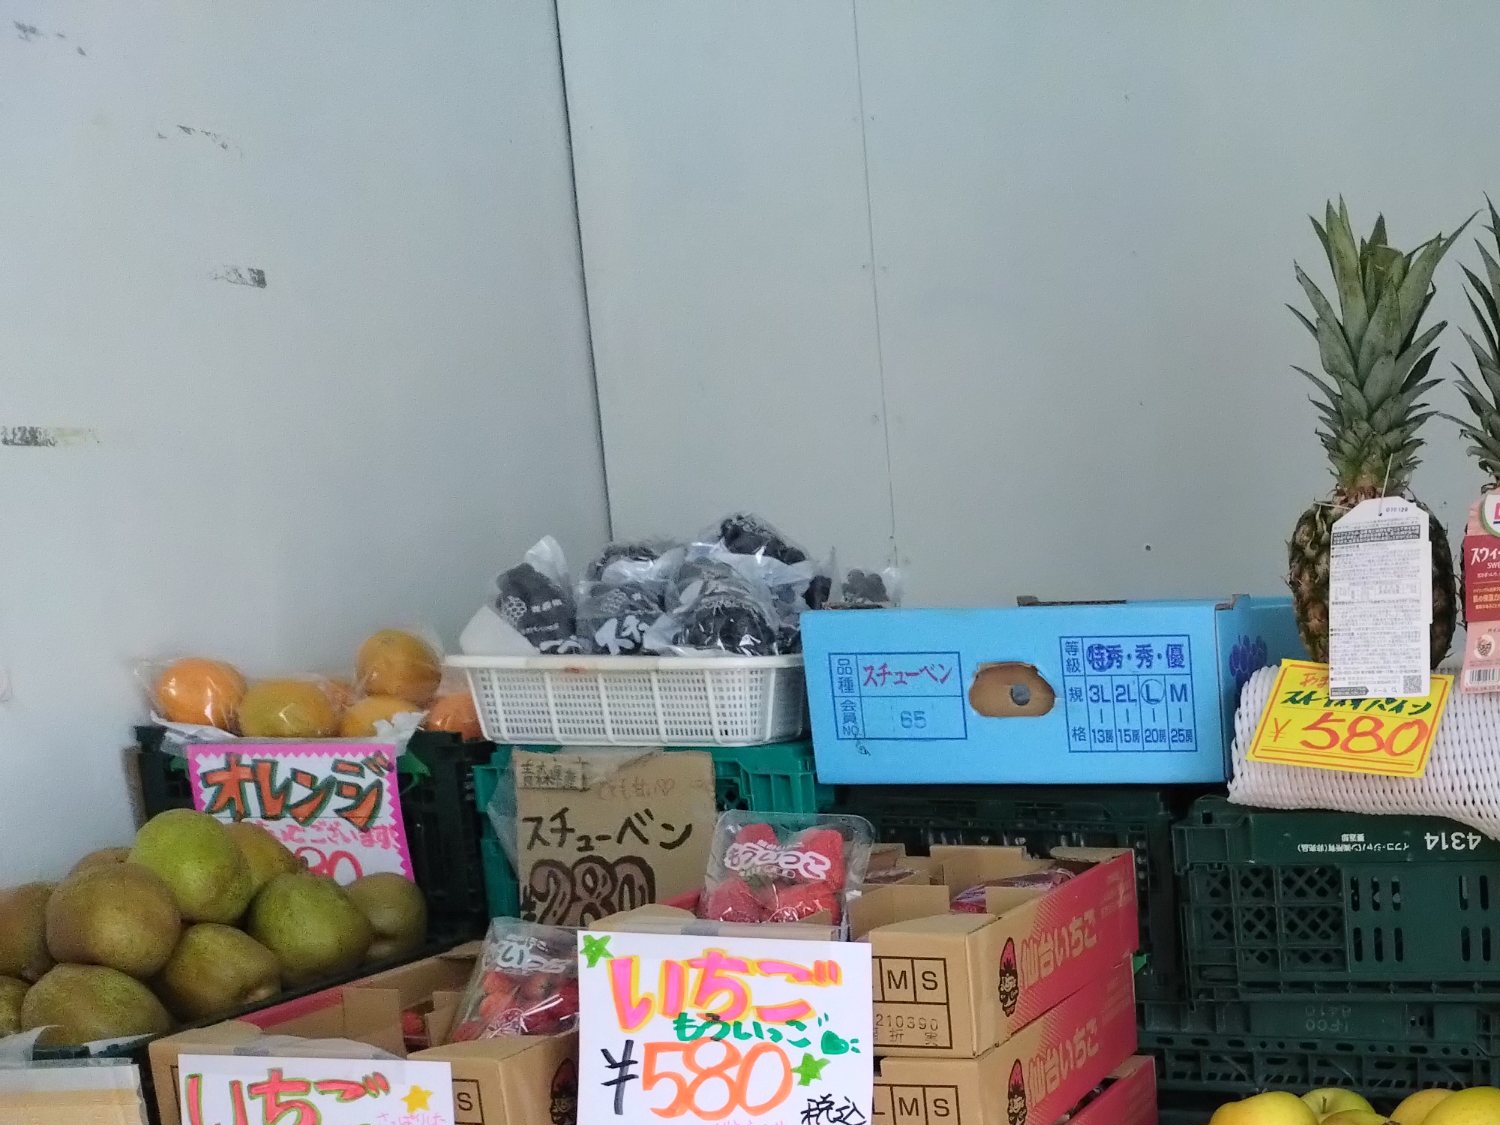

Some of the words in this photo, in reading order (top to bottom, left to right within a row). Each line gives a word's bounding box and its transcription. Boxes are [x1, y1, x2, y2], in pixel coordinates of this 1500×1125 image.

[837, 659, 855, 694] 品種
[863, 663, 953, 688] スチューベン
[1088, 686, 1110, 704] 3L
[1115, 685, 1136, 703] 2L
[1170, 684, 1188, 702] M
[900, 711, 927, 729] 65
[200, 751, 394, 832] オレンジ
[523, 807, 693, 852] スチューベン
[1424, 831, 1483, 850] 4314
[887, 970, 908, 991] M
[922, 971, 939, 991] S
[606, 948, 843, 1034] いちご
[458, 1092, 473, 1111] S
[899, 1097, 920, 1117] M
[933, 1097, 950, 1117] S
